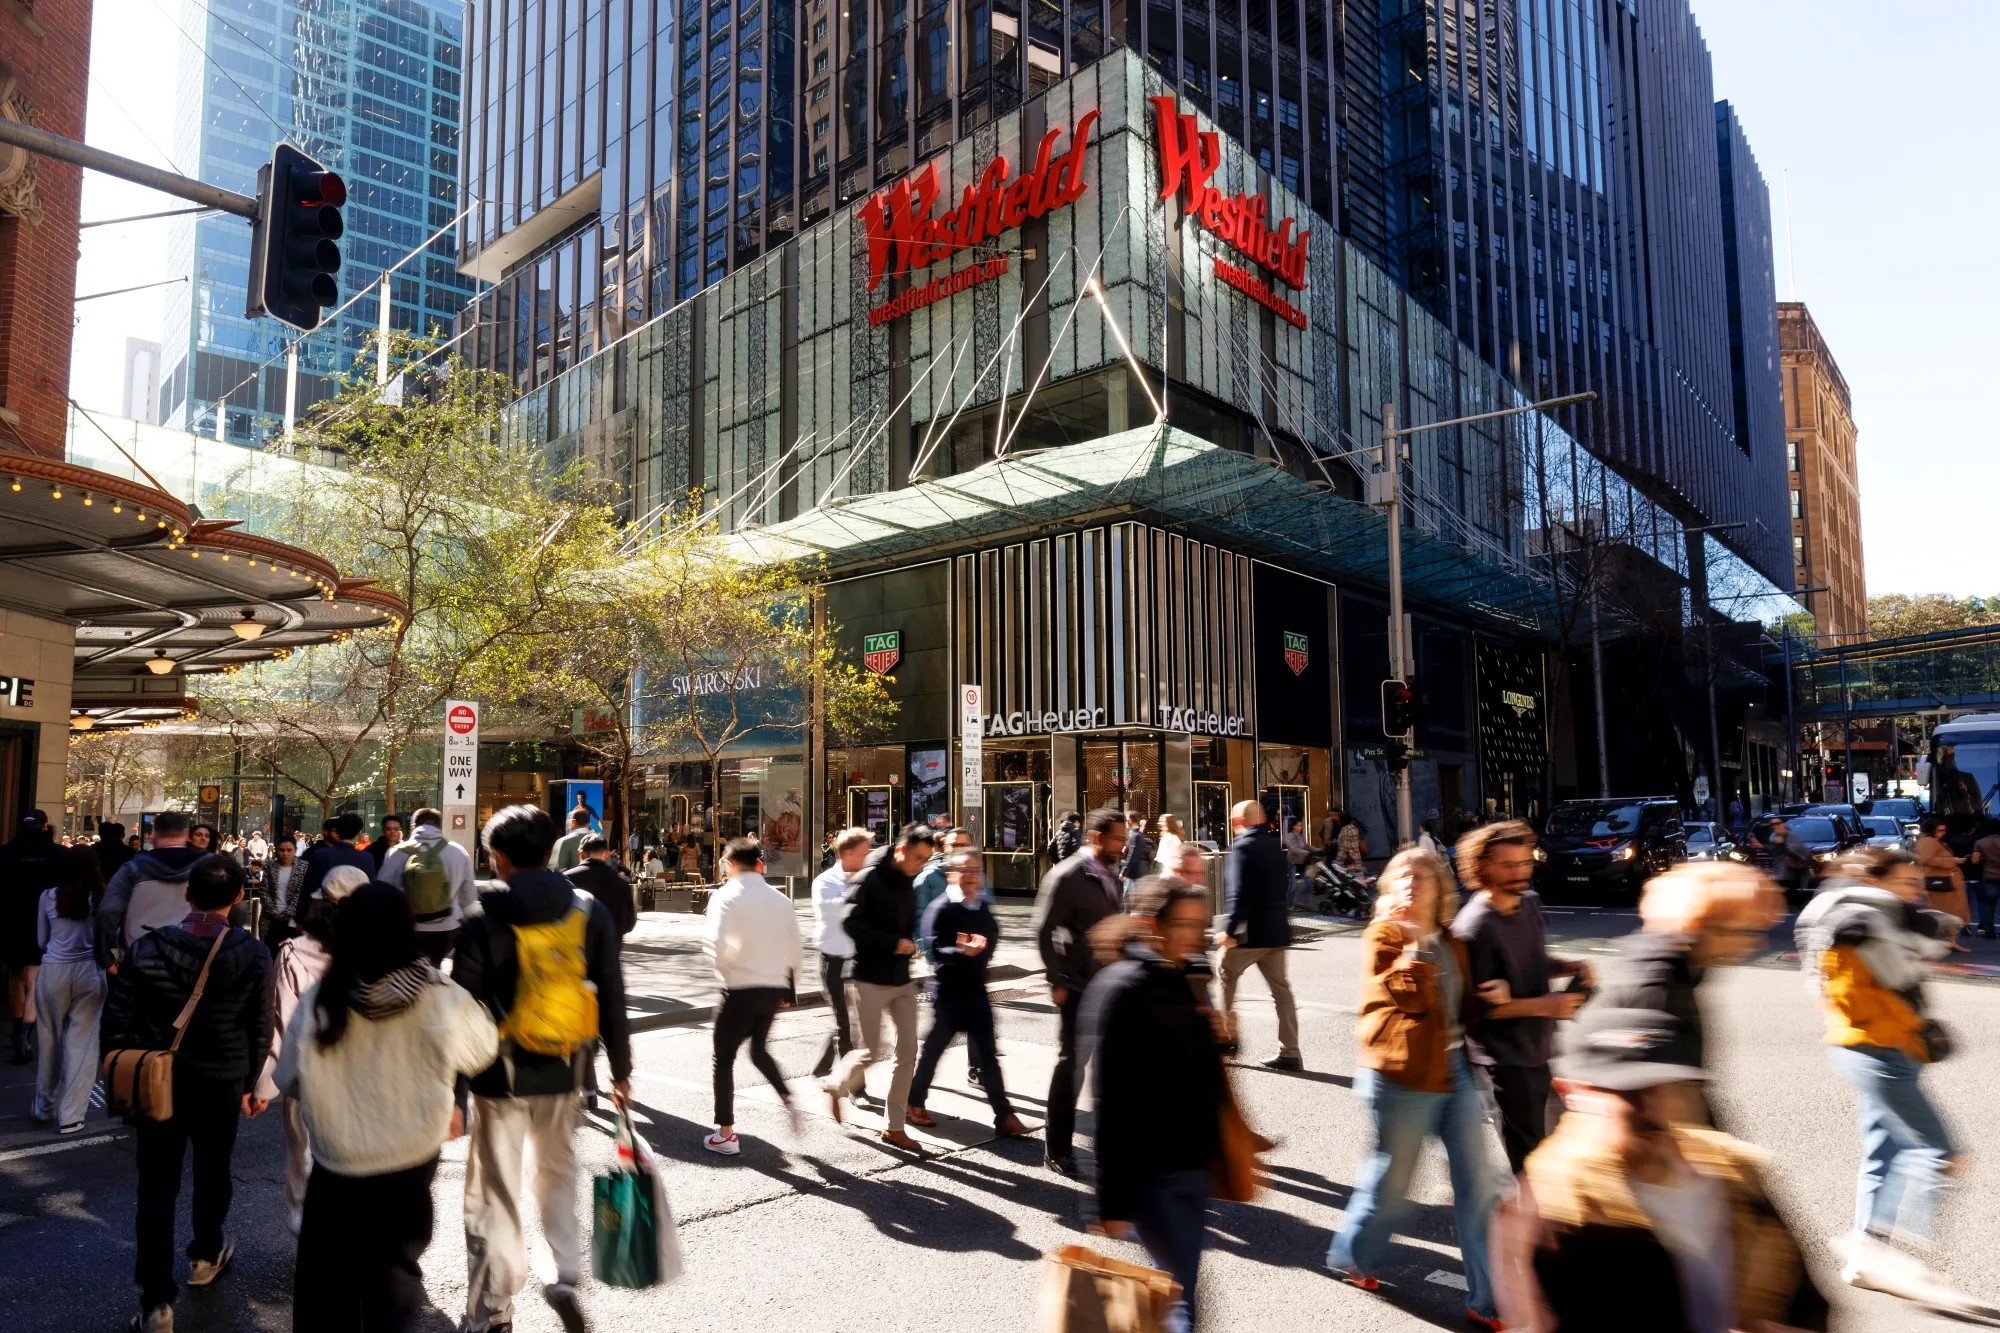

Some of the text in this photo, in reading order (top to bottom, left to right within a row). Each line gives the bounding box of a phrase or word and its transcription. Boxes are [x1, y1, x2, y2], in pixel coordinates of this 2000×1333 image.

[857, 109, 1099, 292] Westfield
[1148, 96, 1311, 291] Westfield
[868, 253, 1008, 327] westfield.com.au
[1213, 256, 1308, 331] westfield.com.au
[867, 634, 896, 651] TAG
[1286, 634, 1306, 652] TAG
[866, 651, 897, 673] HEUER
[1286, 650, 1307, 673] HEUER
[1502, 690, 1534, 709] LONGINES
[450, 755, 472, 766] ONE
[448, 767, 472, 778] WAY
[965, 767, 971, 777] P
